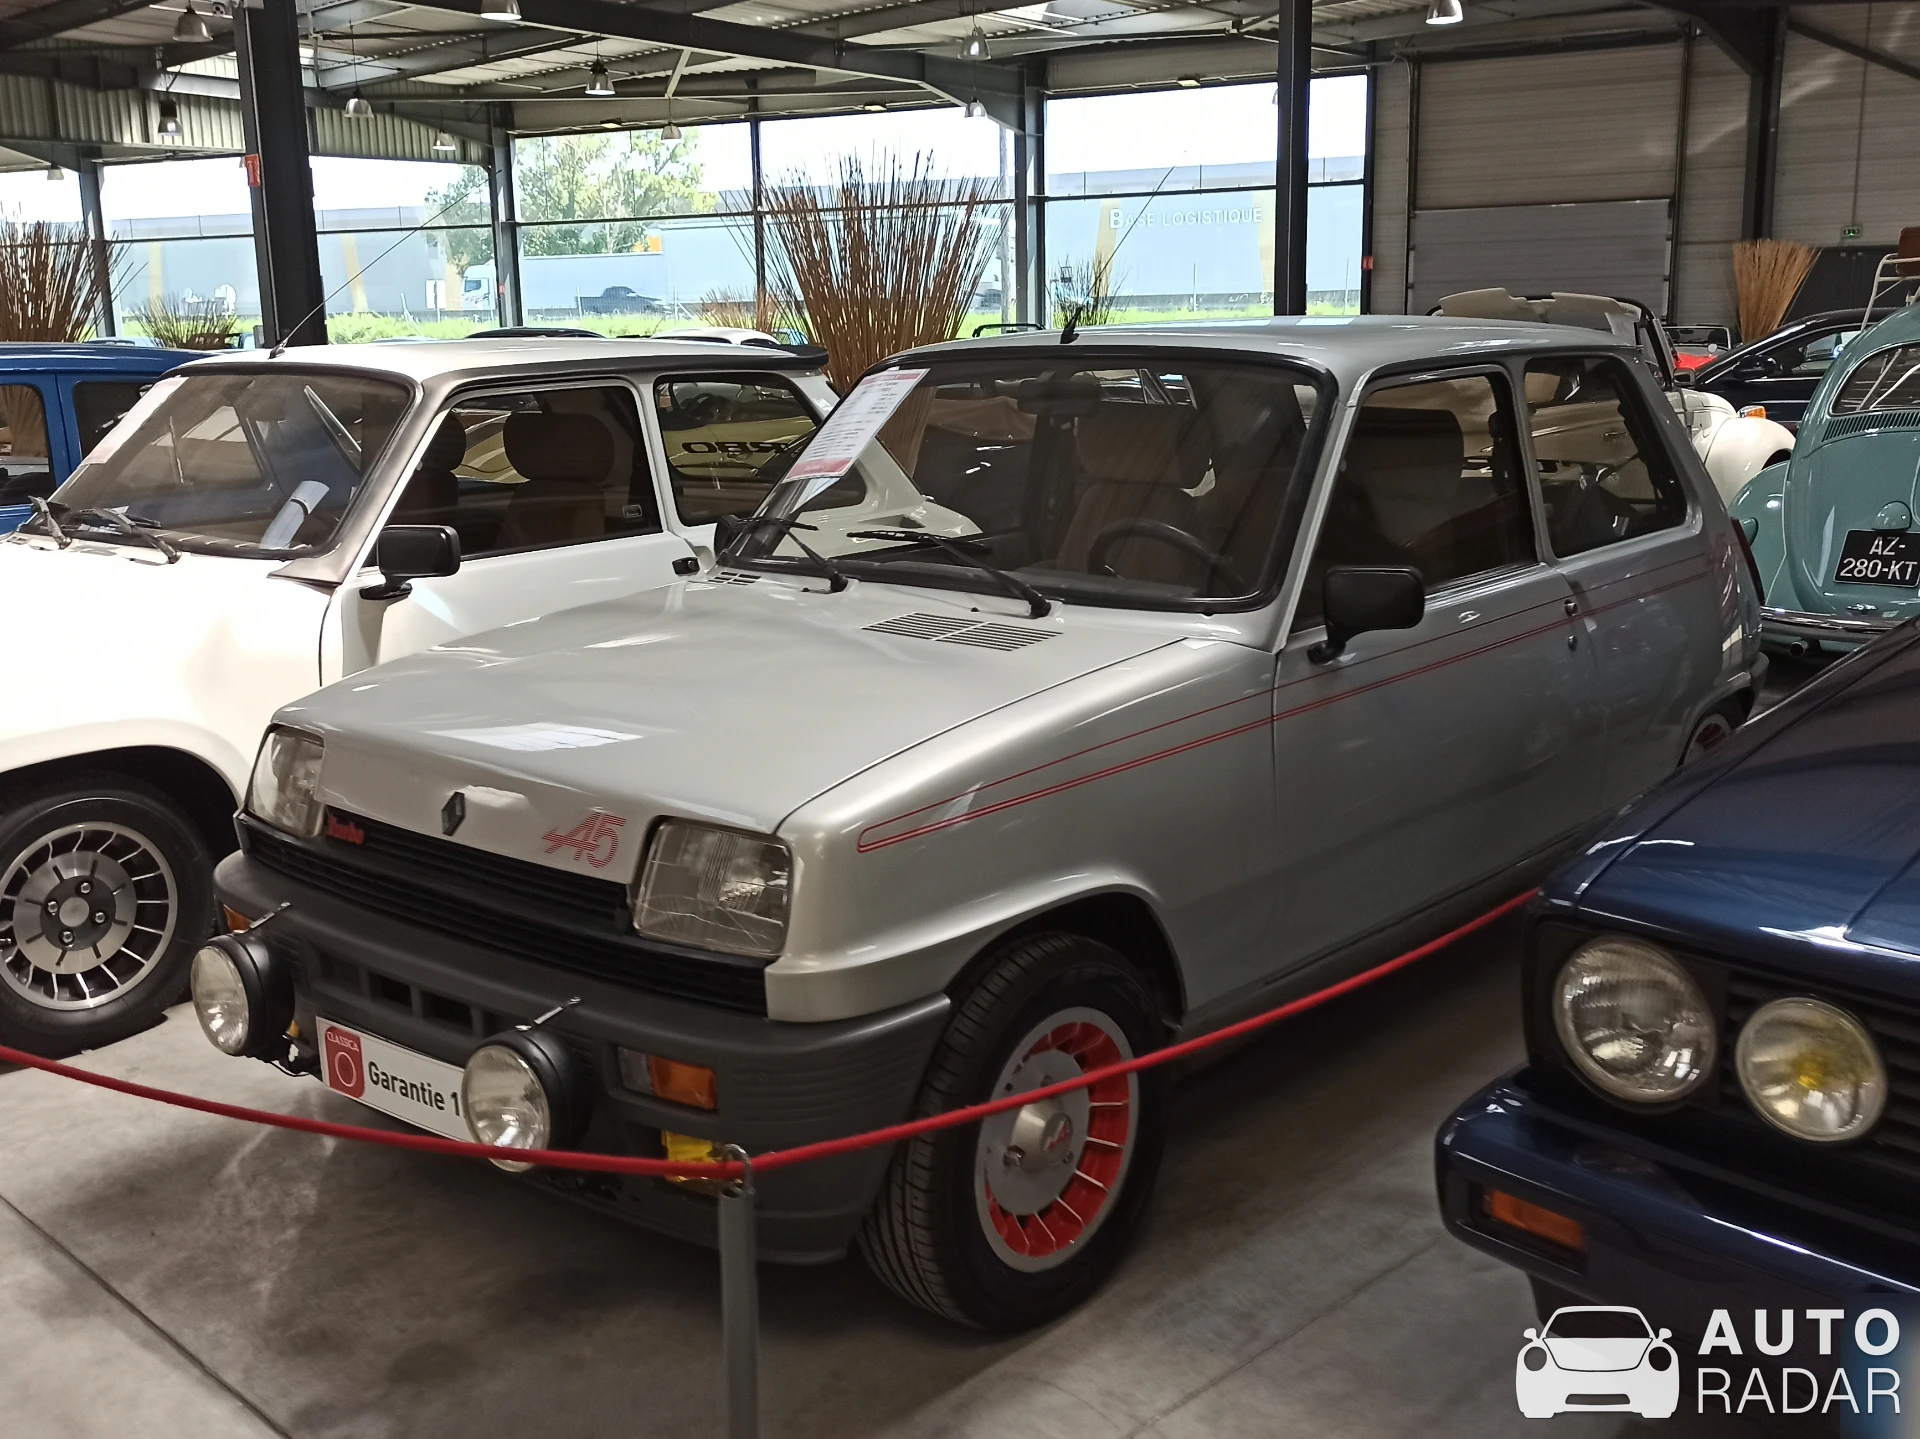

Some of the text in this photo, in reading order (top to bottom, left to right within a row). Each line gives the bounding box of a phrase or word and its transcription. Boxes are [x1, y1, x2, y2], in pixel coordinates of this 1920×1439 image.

[1162, 208, 1264, 226] LOGISTIQUE
[1840, 557, 1918, 580] 280-KT
[367, 1061, 446, 1111] Garantie
